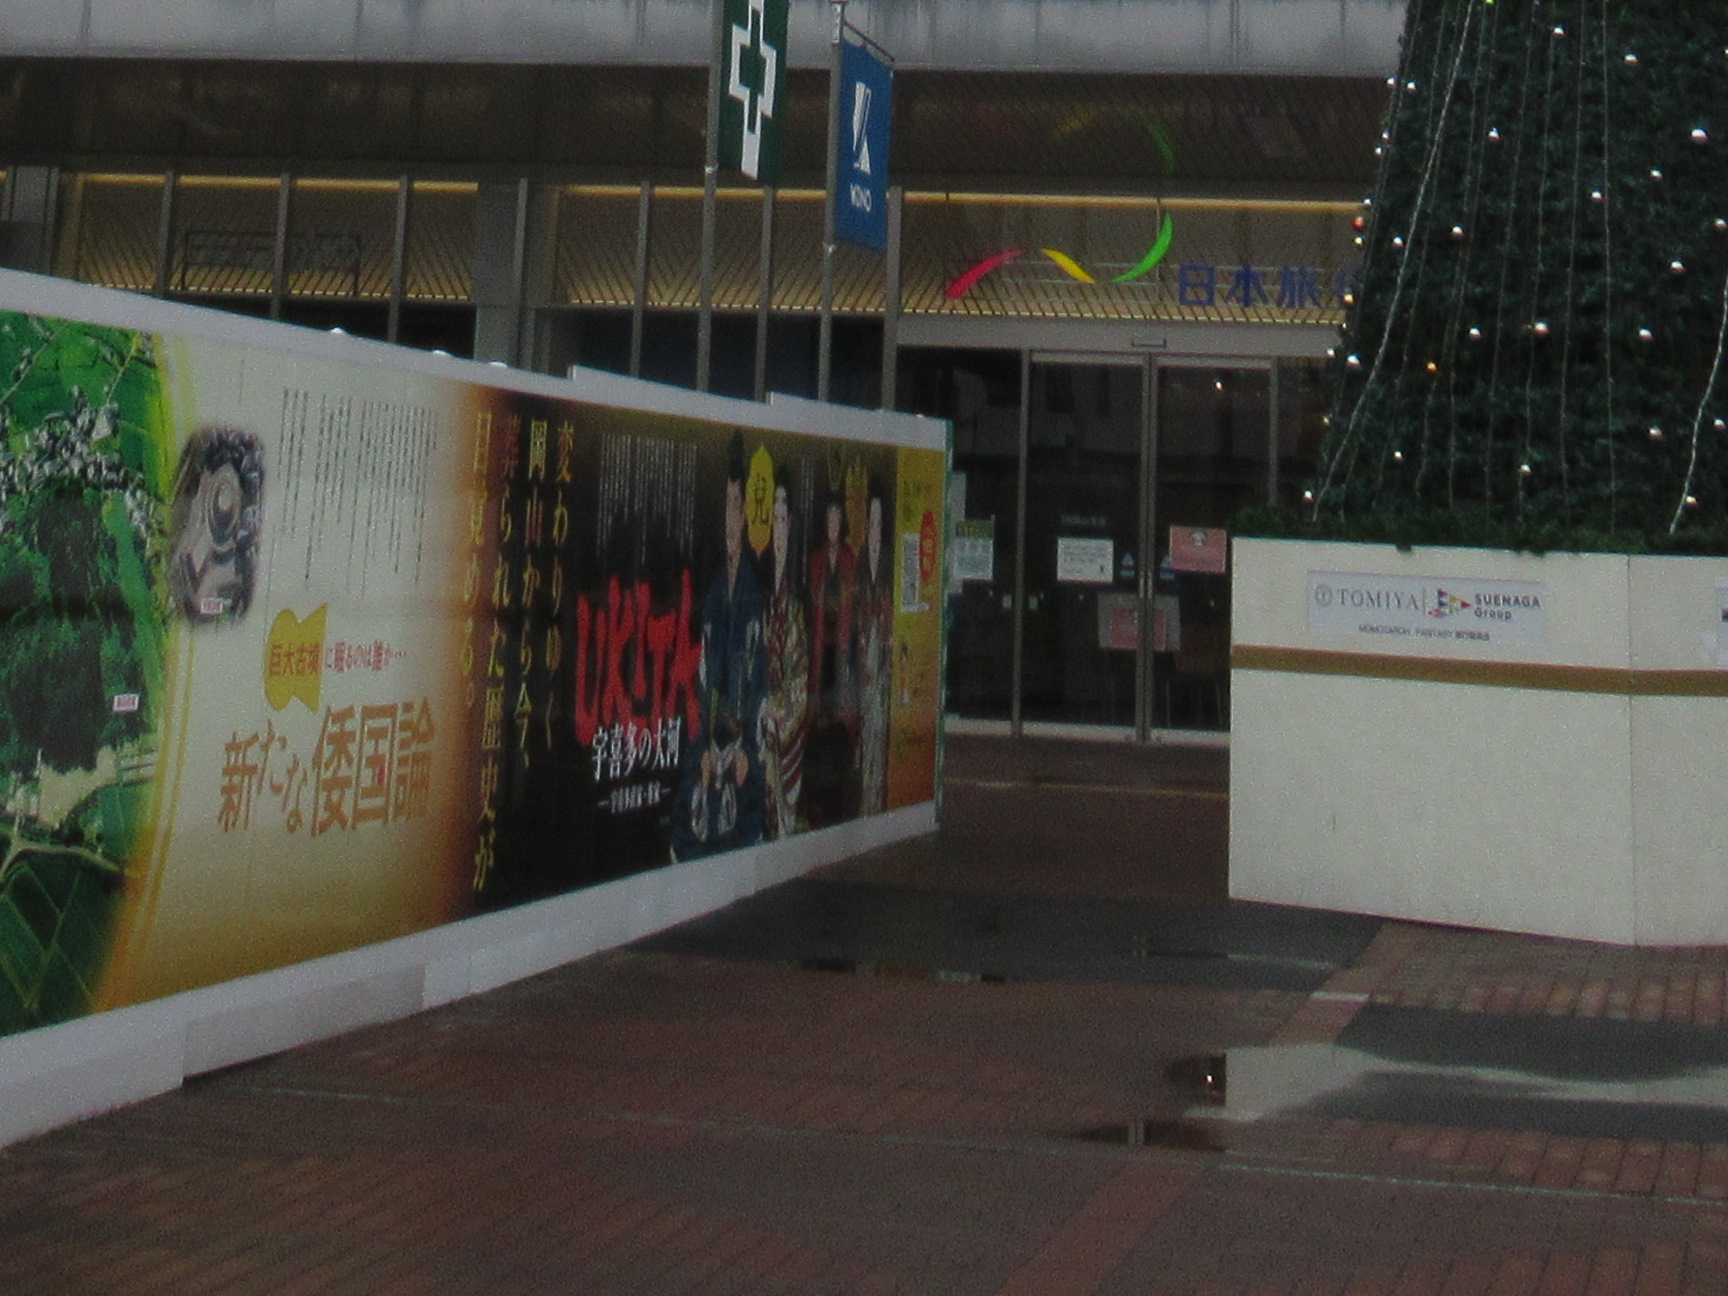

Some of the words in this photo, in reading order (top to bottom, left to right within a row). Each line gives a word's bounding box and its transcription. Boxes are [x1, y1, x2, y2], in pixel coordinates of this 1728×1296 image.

[515, 418, 549, 768] 岡山から今、
[544, 419, 575, 750] 変わりゆく
[1337, 588, 1422, 611] TOMIYA
[1474, 592, 1541, 609] SUENAGA
[1473, 608, 1512, 621] Group
